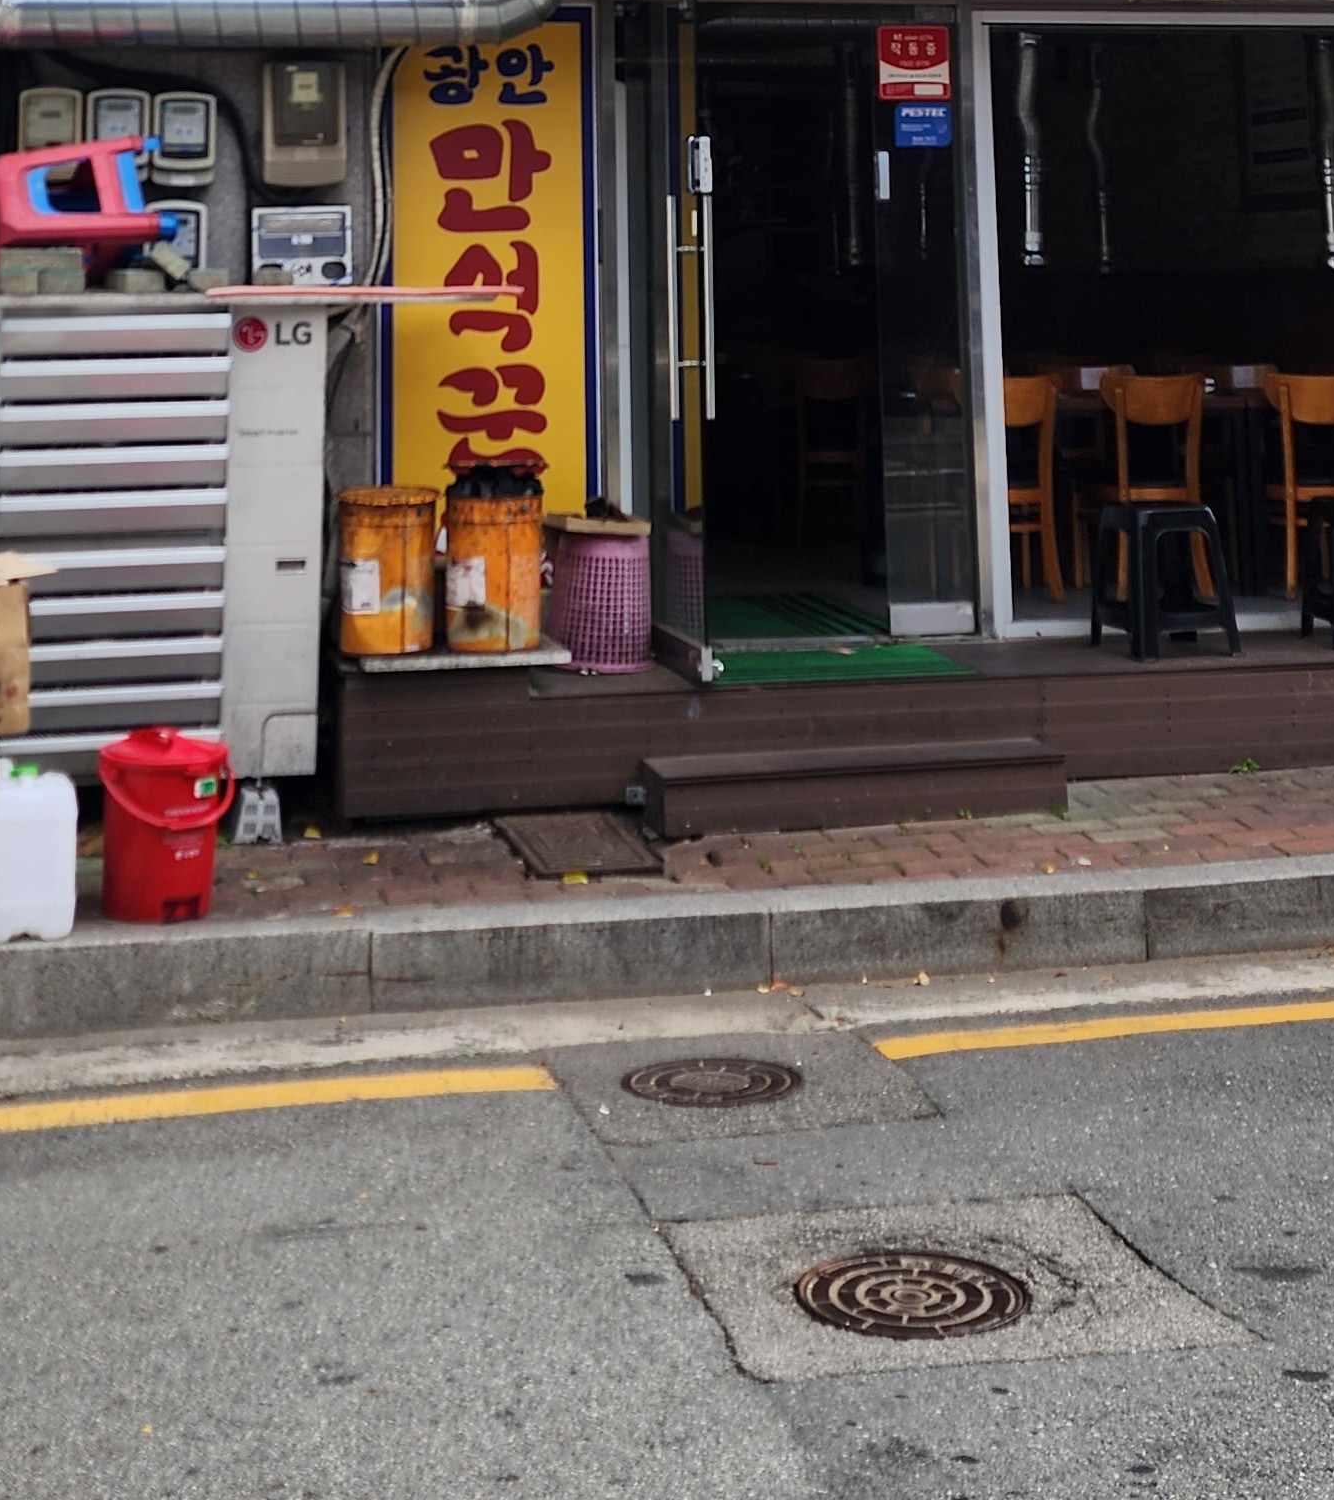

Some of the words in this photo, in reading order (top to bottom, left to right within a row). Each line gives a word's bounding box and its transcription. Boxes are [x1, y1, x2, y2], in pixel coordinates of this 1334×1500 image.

[423, 43, 554, 106] 광안
[429, 118, 553, 477] 만석꾼
[275, 321, 312, 346] LG
